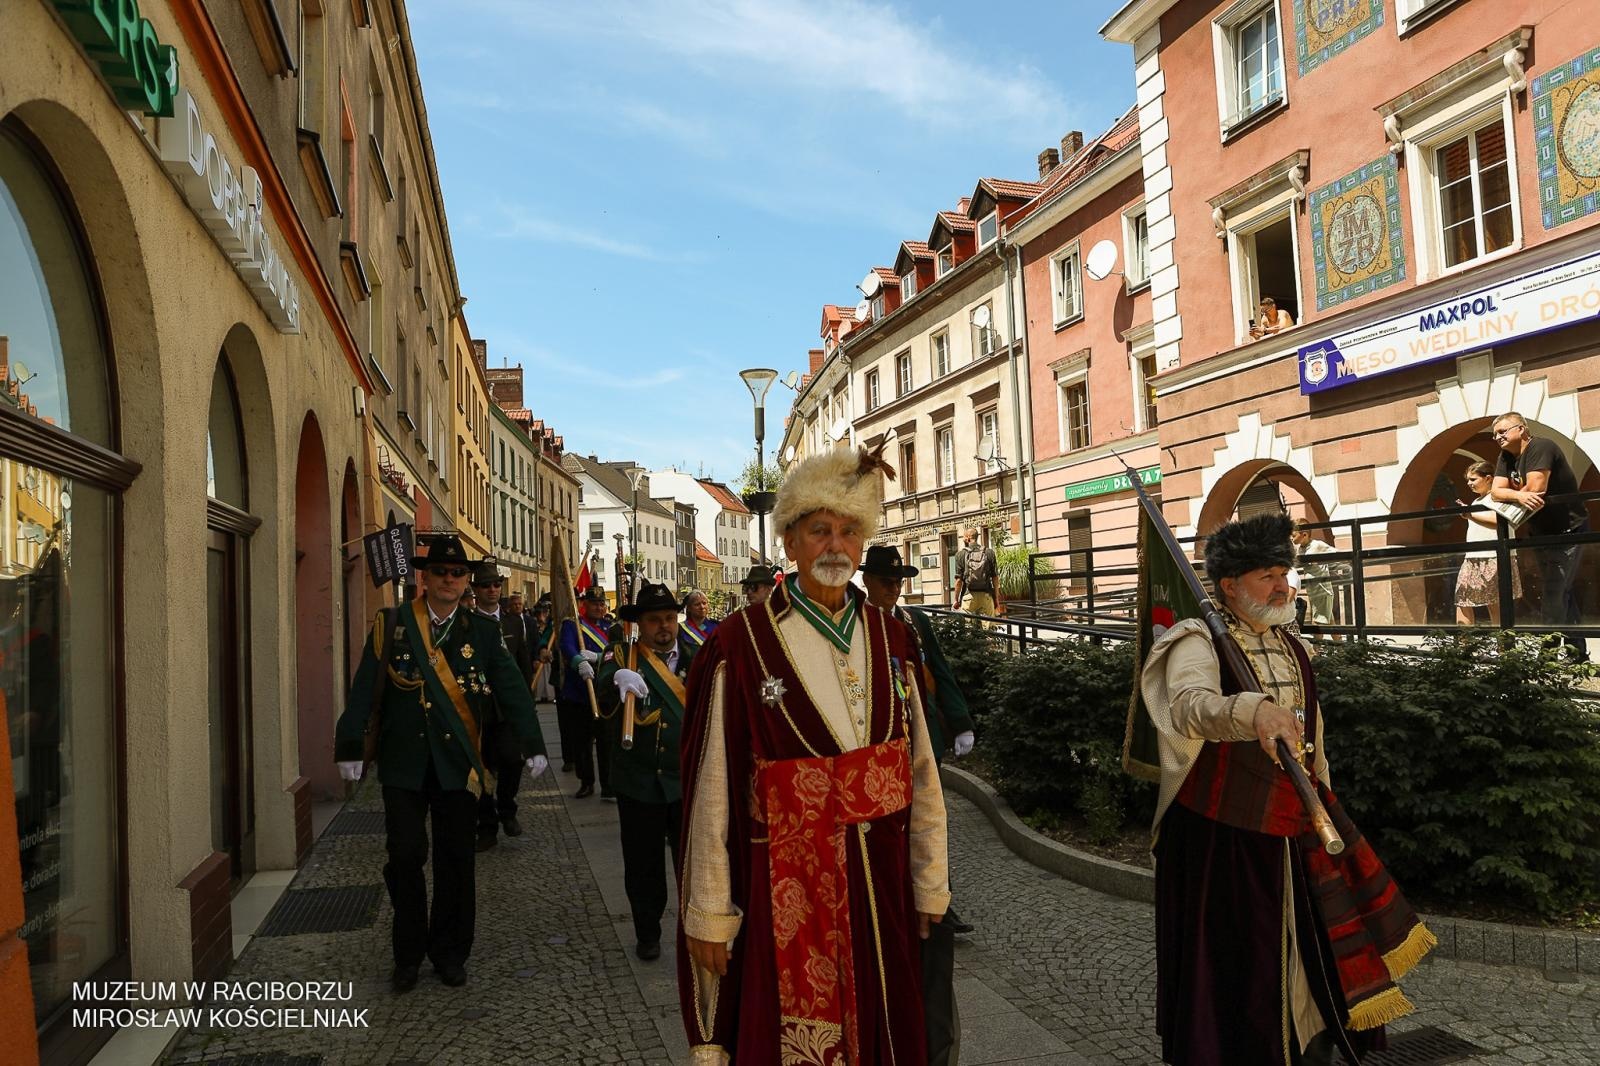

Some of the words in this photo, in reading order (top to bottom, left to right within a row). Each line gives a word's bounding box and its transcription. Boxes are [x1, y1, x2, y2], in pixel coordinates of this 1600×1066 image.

[1419, 294, 1498, 332] MAXPOL
[1335, 347, 1397, 380] MIĘSO
[1408, 310, 1519, 353] WĘDLINY
[390, 528, 408, 575] GLASSARIO
